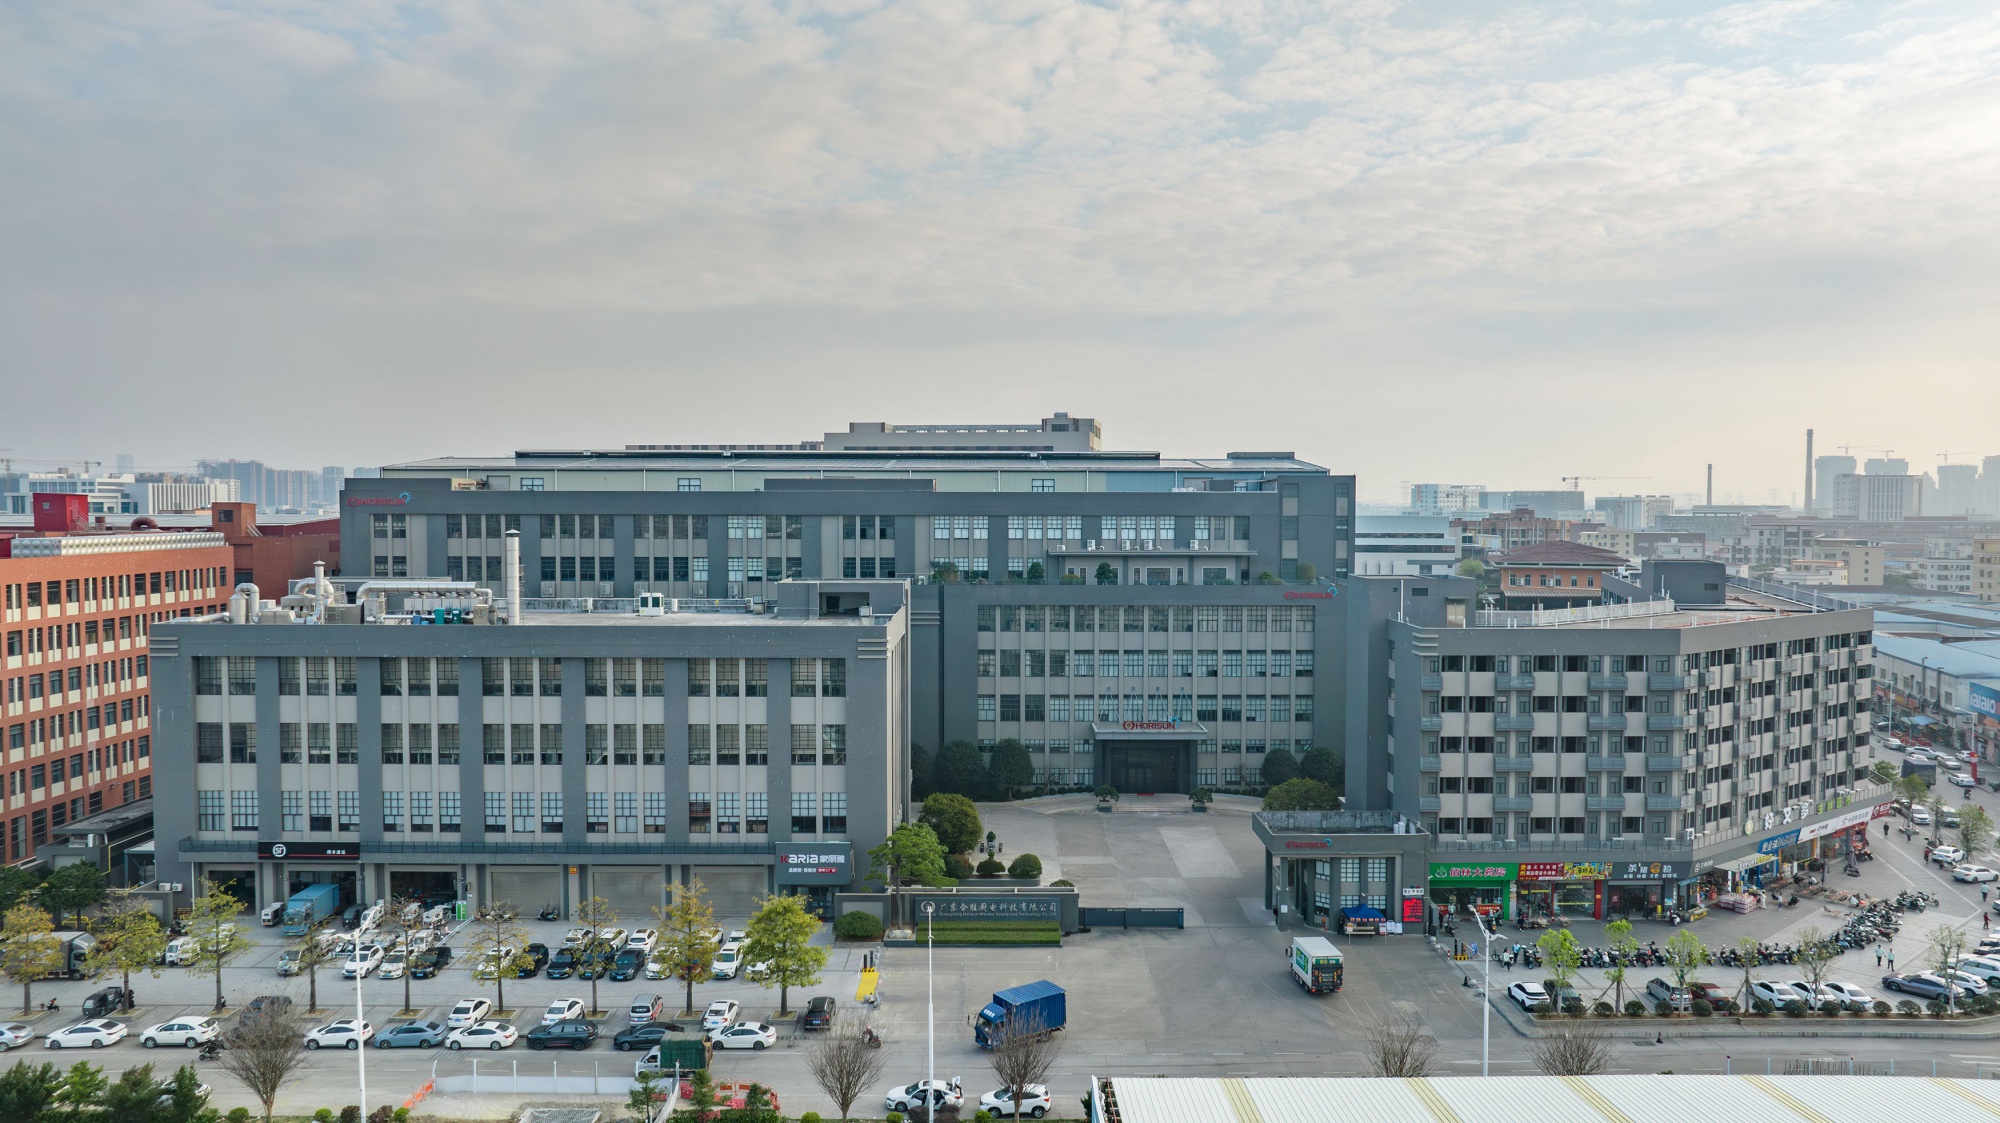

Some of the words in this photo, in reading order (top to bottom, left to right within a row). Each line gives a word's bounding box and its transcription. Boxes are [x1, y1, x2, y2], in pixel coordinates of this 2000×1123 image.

[1449, 867, 1506, 877] 佰林大药房
[939, 902, 1057, 912] 广东合胜厨电科技有限公司
